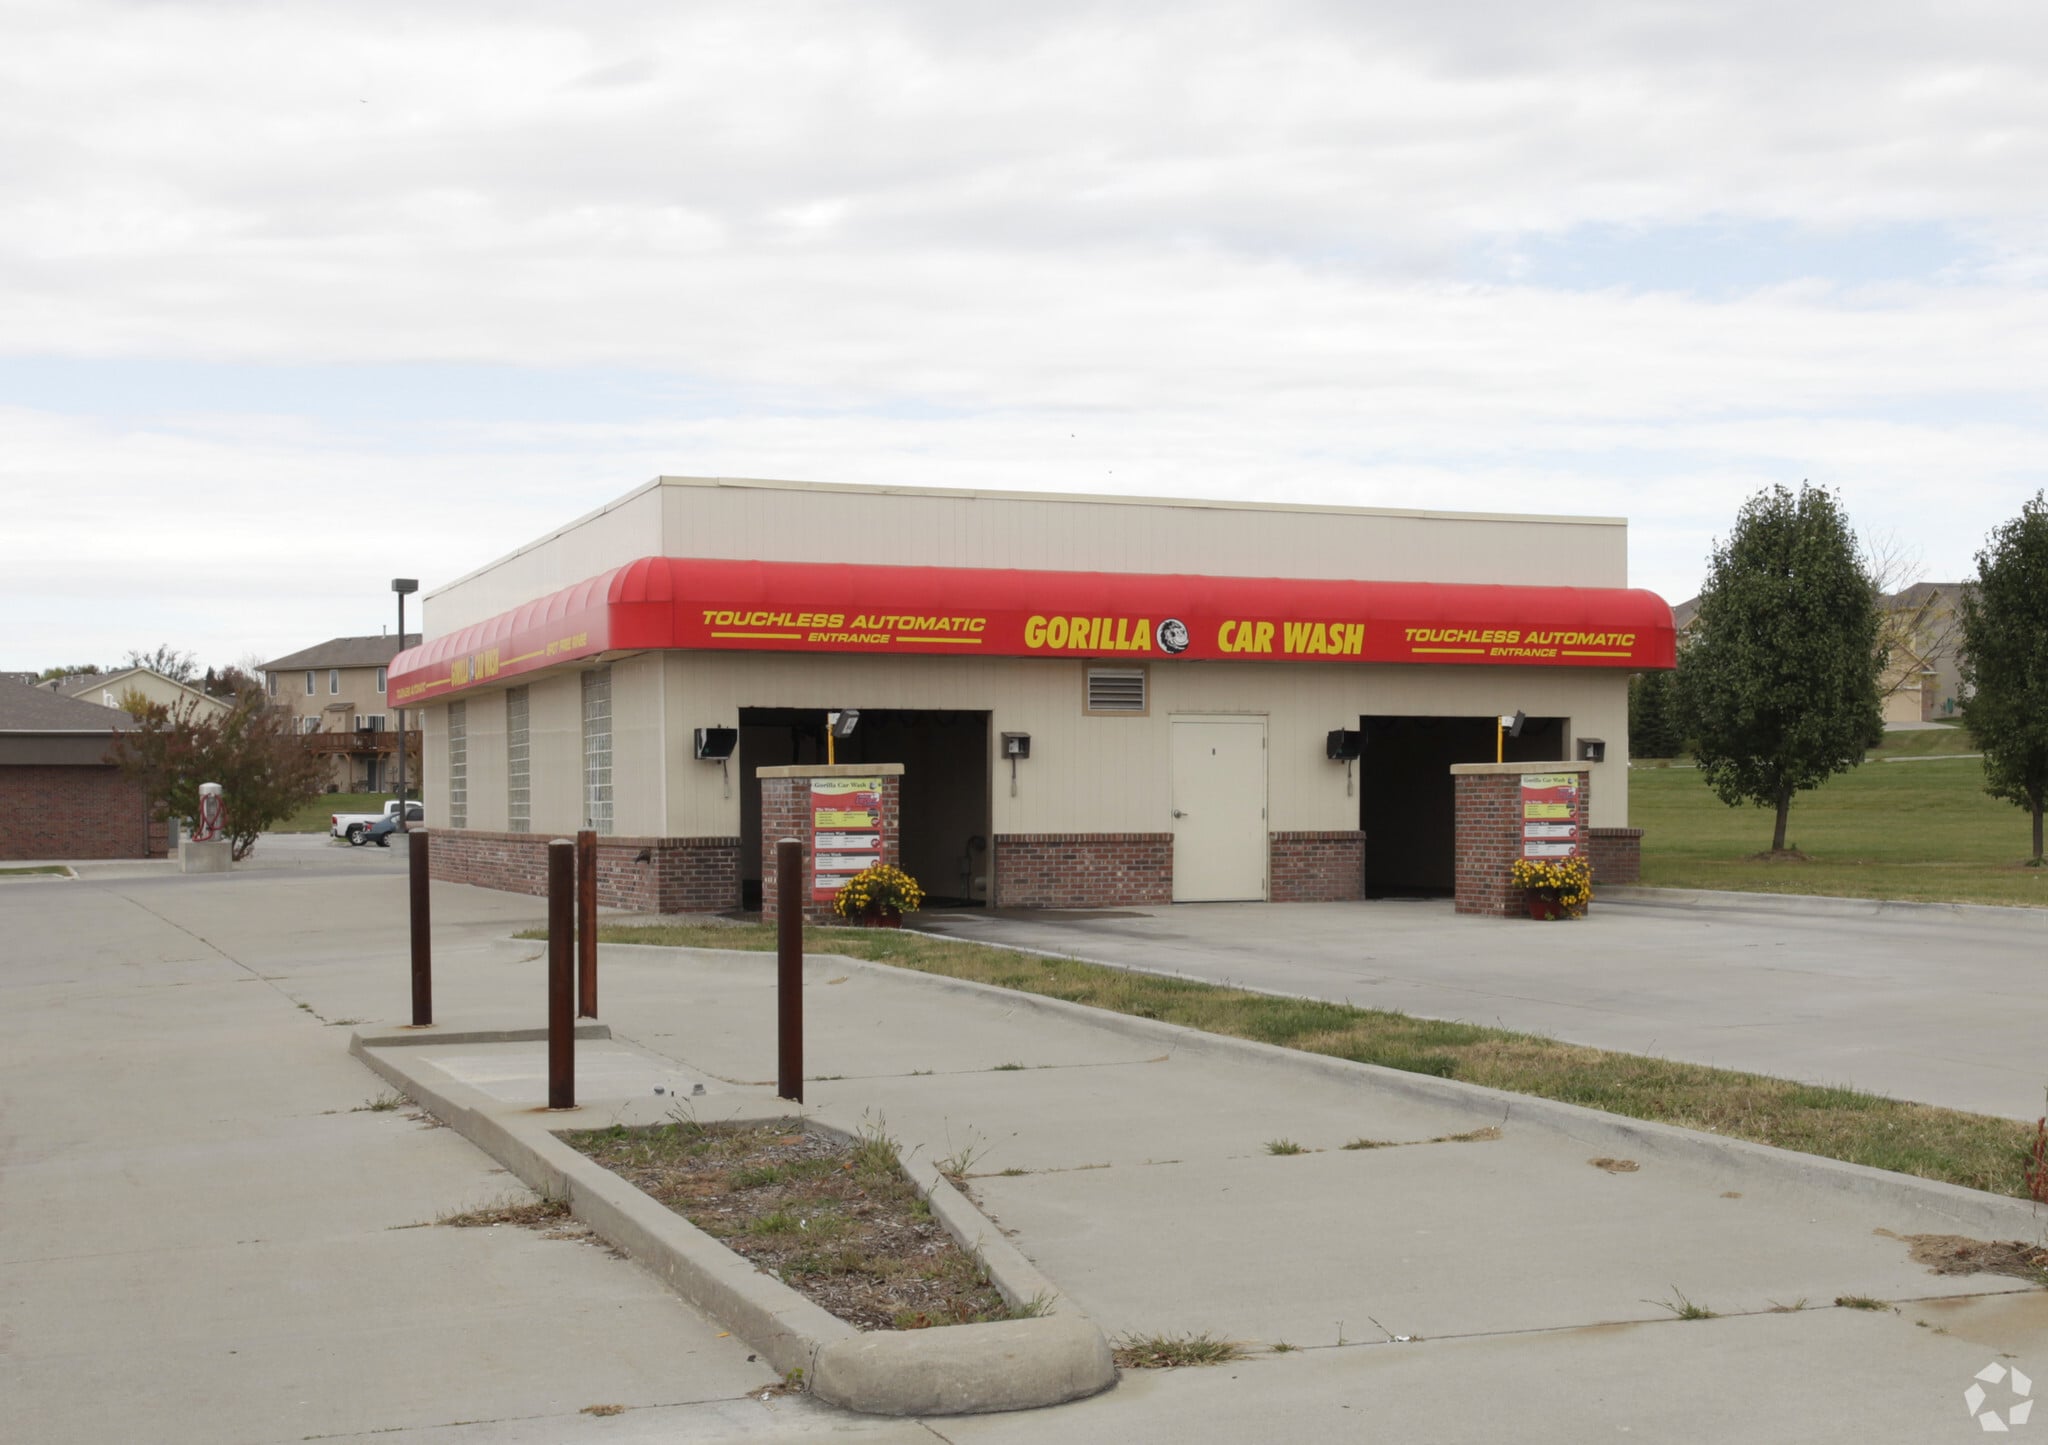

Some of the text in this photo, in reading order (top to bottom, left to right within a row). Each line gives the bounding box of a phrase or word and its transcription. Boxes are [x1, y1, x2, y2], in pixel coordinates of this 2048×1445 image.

[702, 610, 987, 632] TOUCHLESS AUTOMATIC
[808, 632, 891, 644] ENTRANCE
[1024, 615, 1366, 655] GORILLA CAR WASH
[1404, 628, 1636, 646] TOUCHLESS AUTOMATIC
[1489, 647, 1557, 658] ENTRANCE
